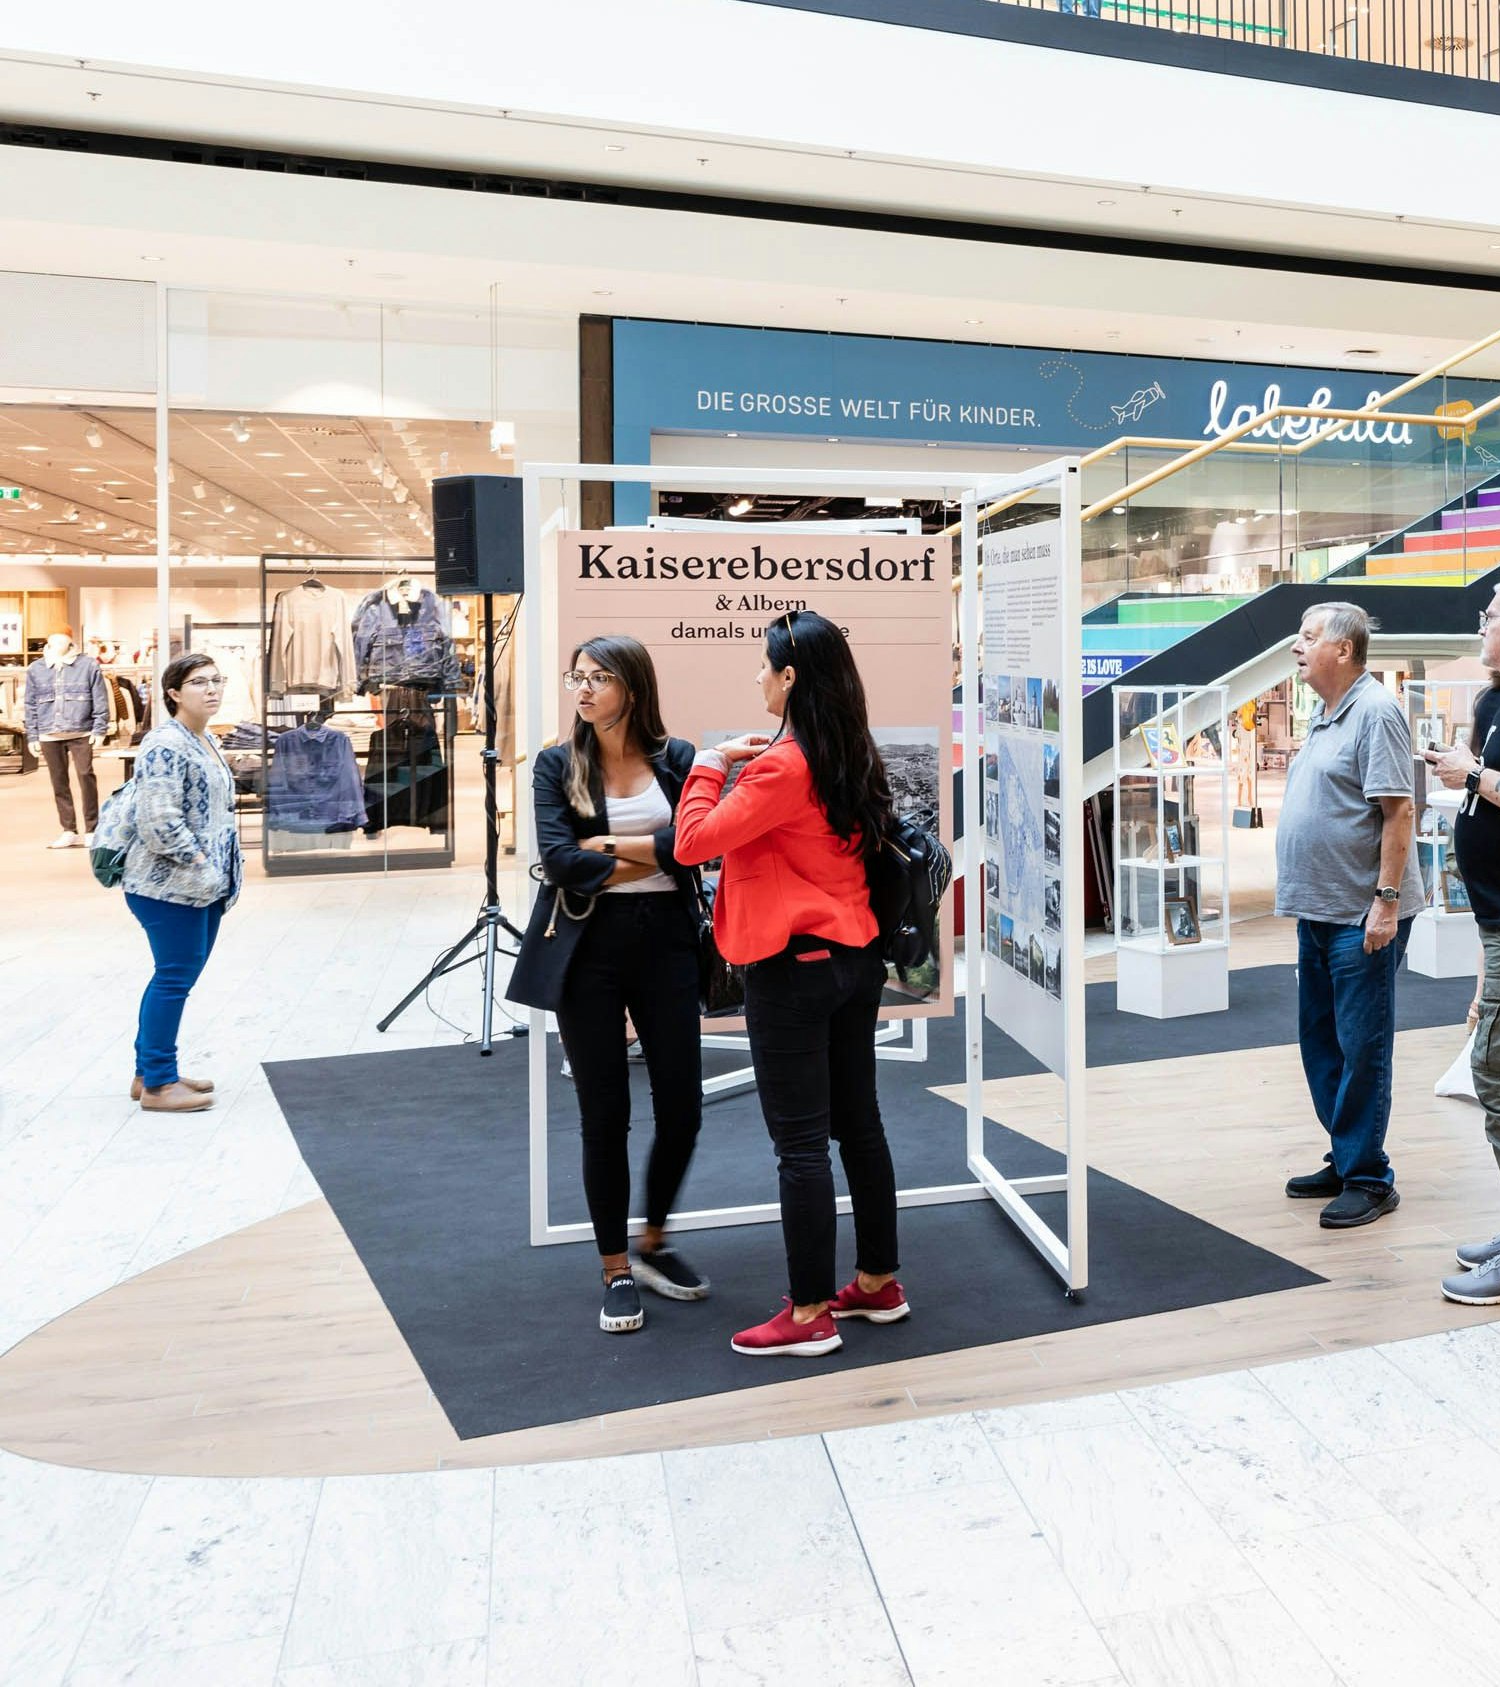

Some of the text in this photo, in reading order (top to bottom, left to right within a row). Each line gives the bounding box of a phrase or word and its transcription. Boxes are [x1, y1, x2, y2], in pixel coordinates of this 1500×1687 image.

[697, 390, 1042, 428] DIE GROSSE WELT FÜR KINDER.
[577, 544, 936, 582] Kaiserebersdorf
[715, 594, 808, 612] & Albern
[671, 621, 744, 639] damals
[1087, 658, 1097, 675] IS
[1096, 658, 1123, 675] LOVE
